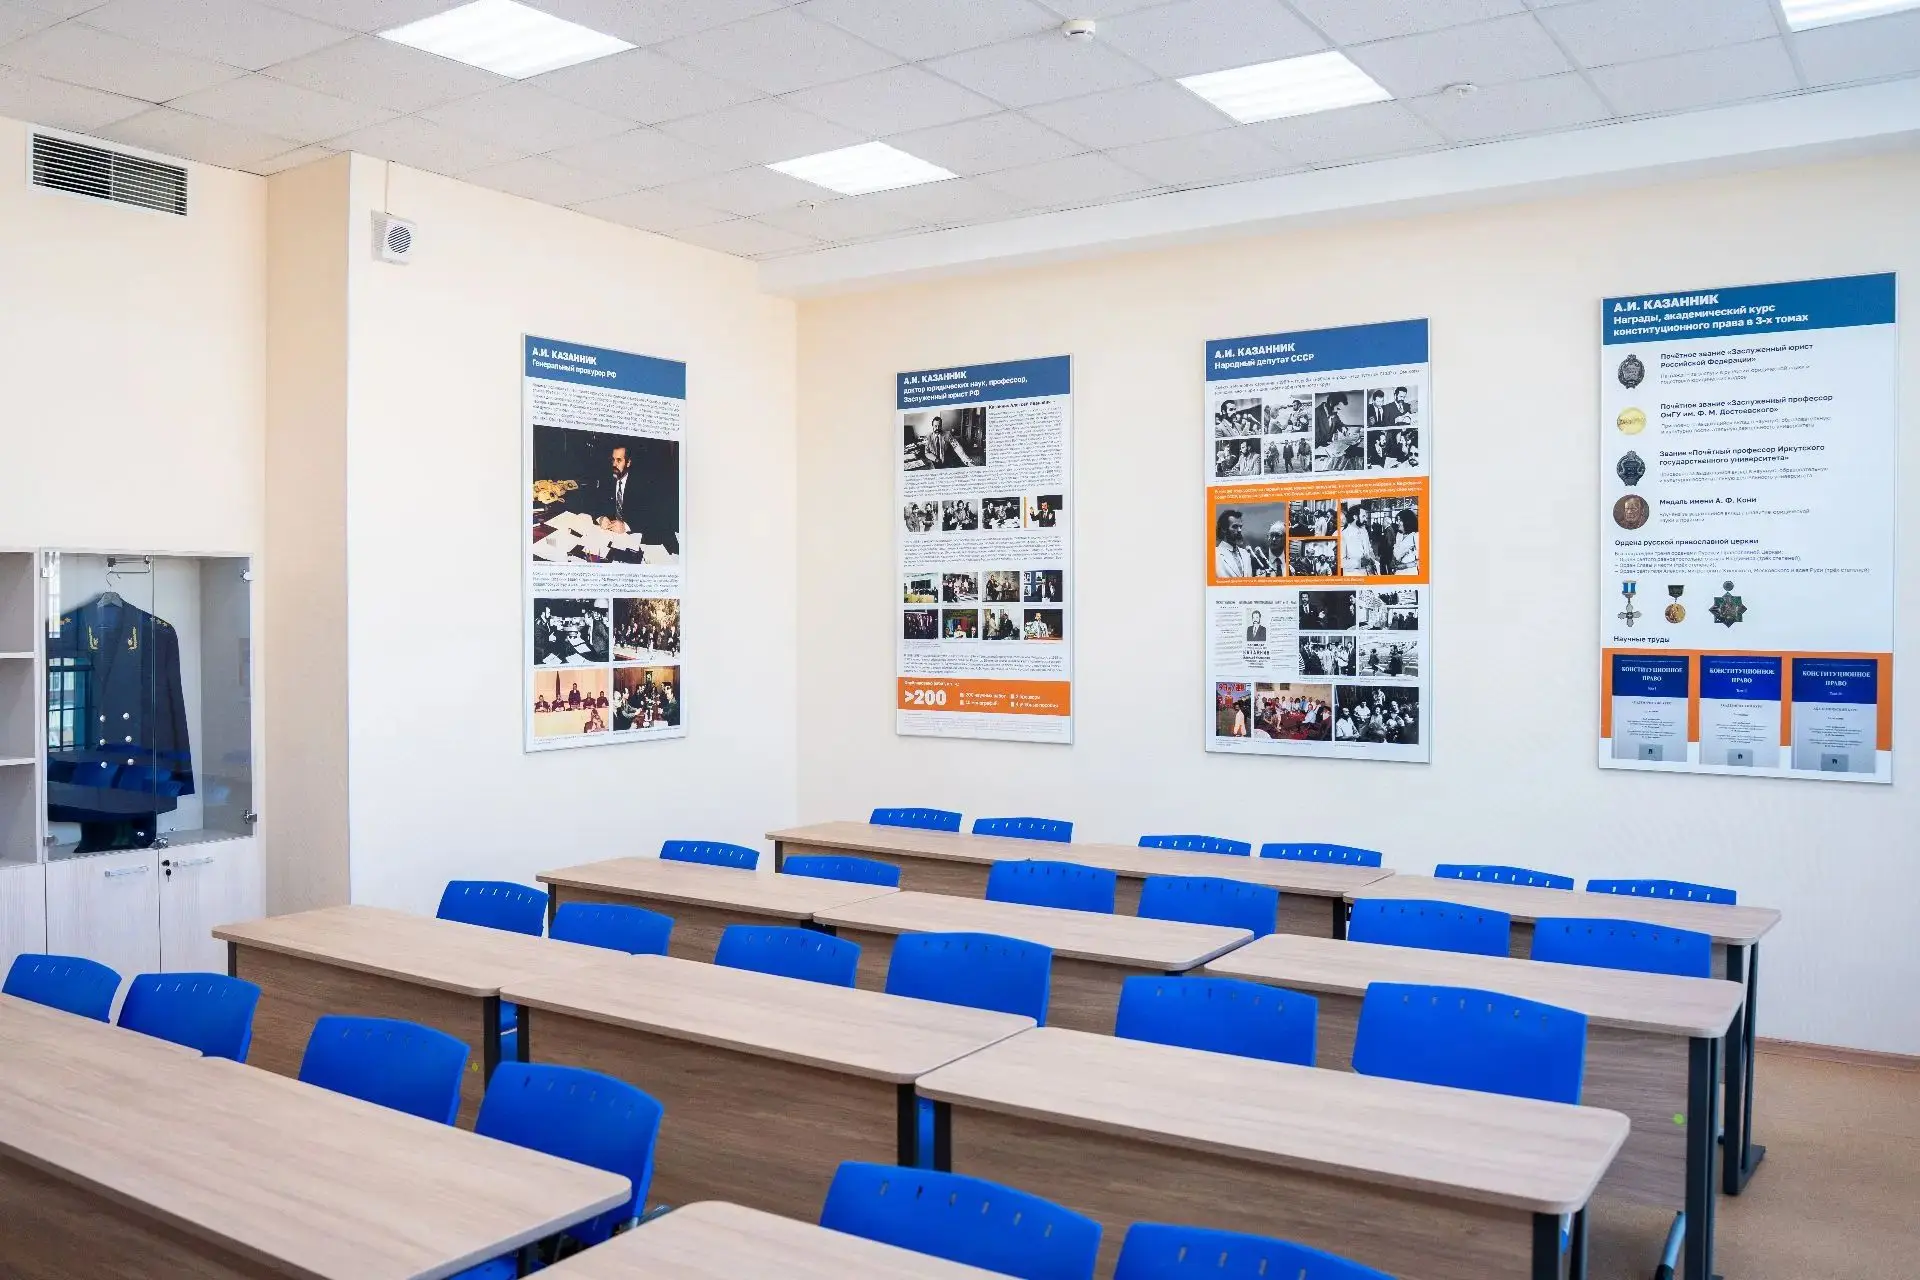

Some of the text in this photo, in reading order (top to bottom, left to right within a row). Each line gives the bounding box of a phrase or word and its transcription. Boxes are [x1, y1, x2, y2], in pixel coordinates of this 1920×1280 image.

[1613, 293, 1719, 312] А.И. КАЗАННИК
[1613, 304, 1776, 324] Награды, академический курс
[1613, 322, 1710, 336] конституционного
[1712, 319, 1745, 330] права
[1755, 316, 1773, 324] 3-х
[1774, 314, 1808, 324] томах
[532, 346, 597, 365] А.И. КАЗАННИК
[1214, 342, 1296, 359] А.И. КАЗАННИК
[532, 358, 617, 379] Генеральный прокурор РФ
[1214, 353, 1314, 370] Народный депутат СССР
[1660, 360, 1706, 368] Российской
[903, 370, 967, 385] А.И. КАЗАННИК
[903, 376, 1028, 394] доктор юридических наук, профессор,
[903, 392, 947, 403] Заслуженный
[948, 391, 968, 400] юрист
[1788, 395, 1833, 404] профессор
[1643, 538, 1674, 547] русской
[904, 689, 947, 706] >200
